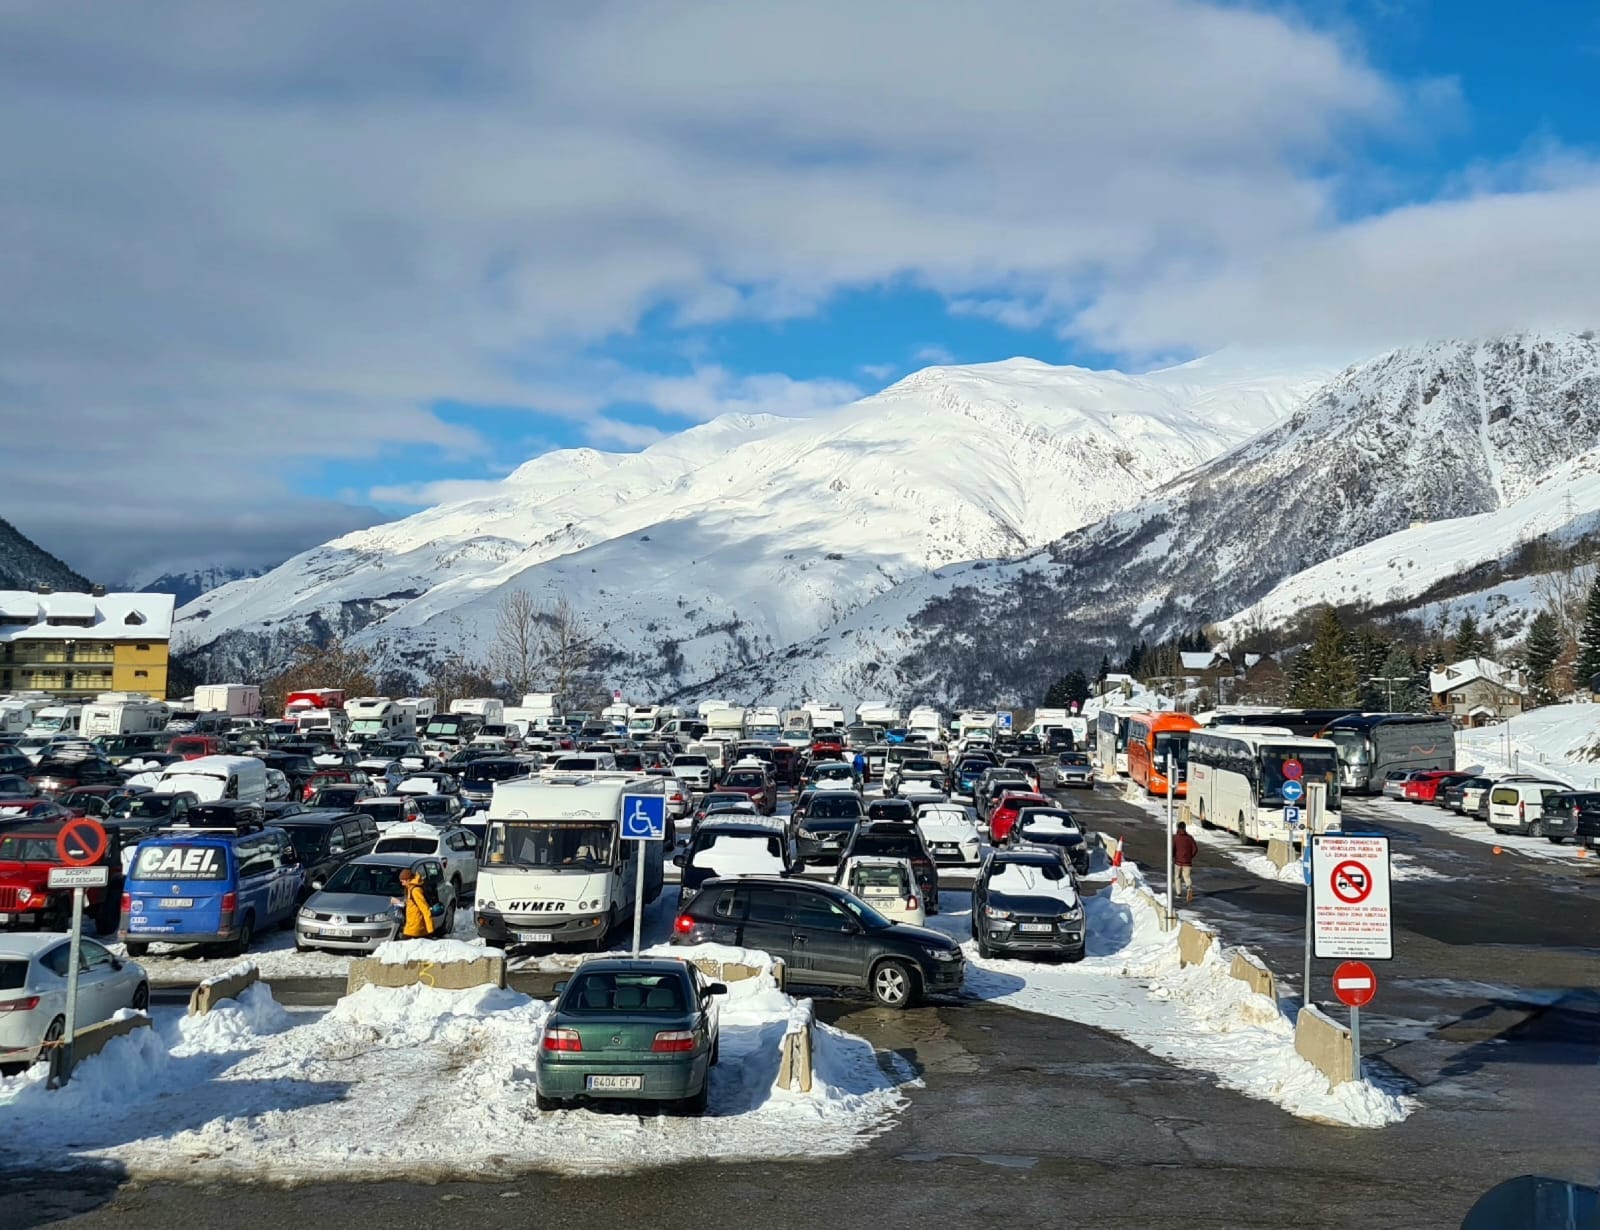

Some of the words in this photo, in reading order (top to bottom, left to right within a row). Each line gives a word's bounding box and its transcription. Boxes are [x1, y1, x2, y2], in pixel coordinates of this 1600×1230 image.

[1286, 809, 1296, 822] P
[508, 901, 566, 911] HYMER
[593, 1077, 616, 1087] 6404
[619, 1077, 638, 1087] CFV
